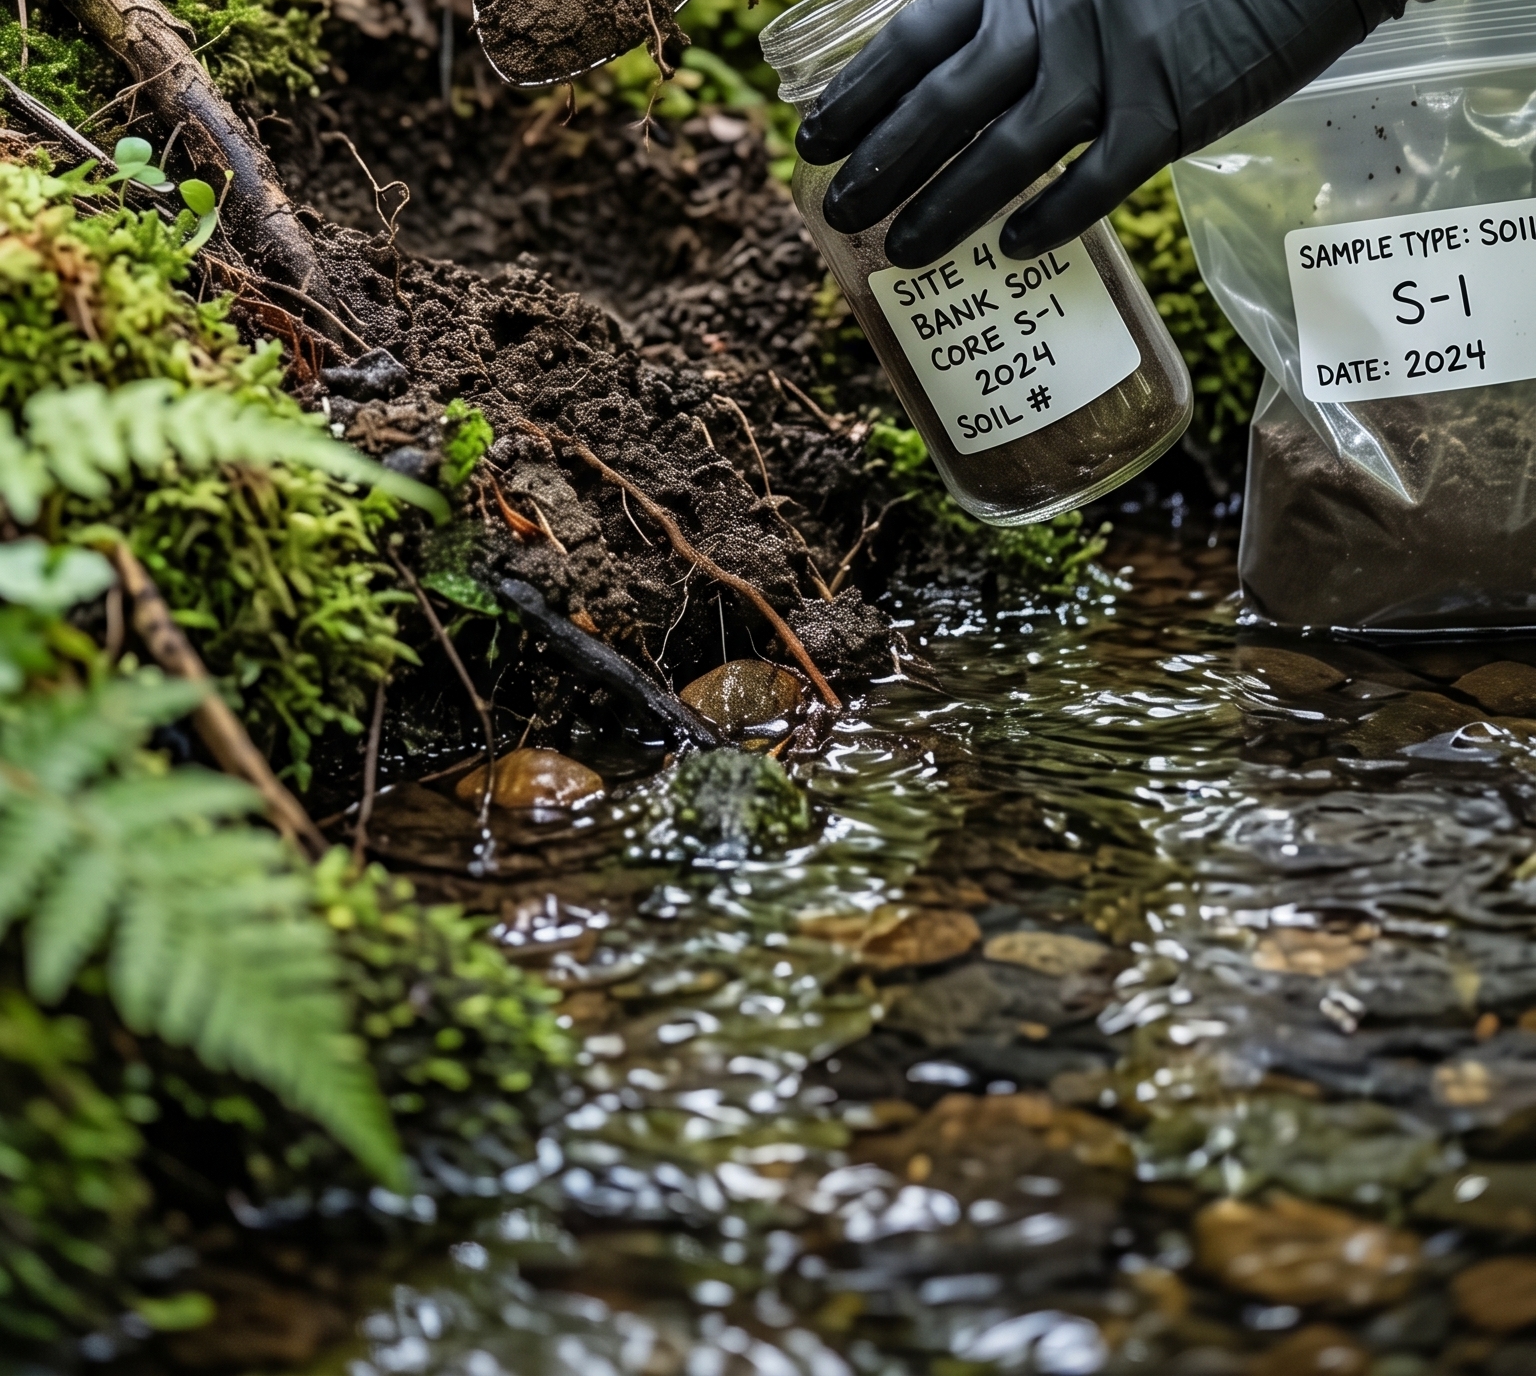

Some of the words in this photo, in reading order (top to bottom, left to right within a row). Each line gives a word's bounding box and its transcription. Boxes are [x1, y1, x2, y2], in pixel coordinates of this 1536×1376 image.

[1300, 235, 1393, 269] SAMPLE
[1400, 225, 1470, 258] TYPE:
[893, 261, 964, 306] SITE
[973, 243, 996, 270] 4
[911, 289, 999, 340] BANK
[1005, 252, 1070, 298] SOIL
[1393, 274, 1471, 324] S-1
[931, 326, 1004, 371] CORE
[1014, 294, 1065, 336] S-1
[975, 341, 1056, 395] 2024
[1317, 359, 1390, 386] DATE:
[1404, 339, 1485, 378] 2024
[957, 405, 1023, 438] SOIL
[1027, 385, 1052, 412] #
